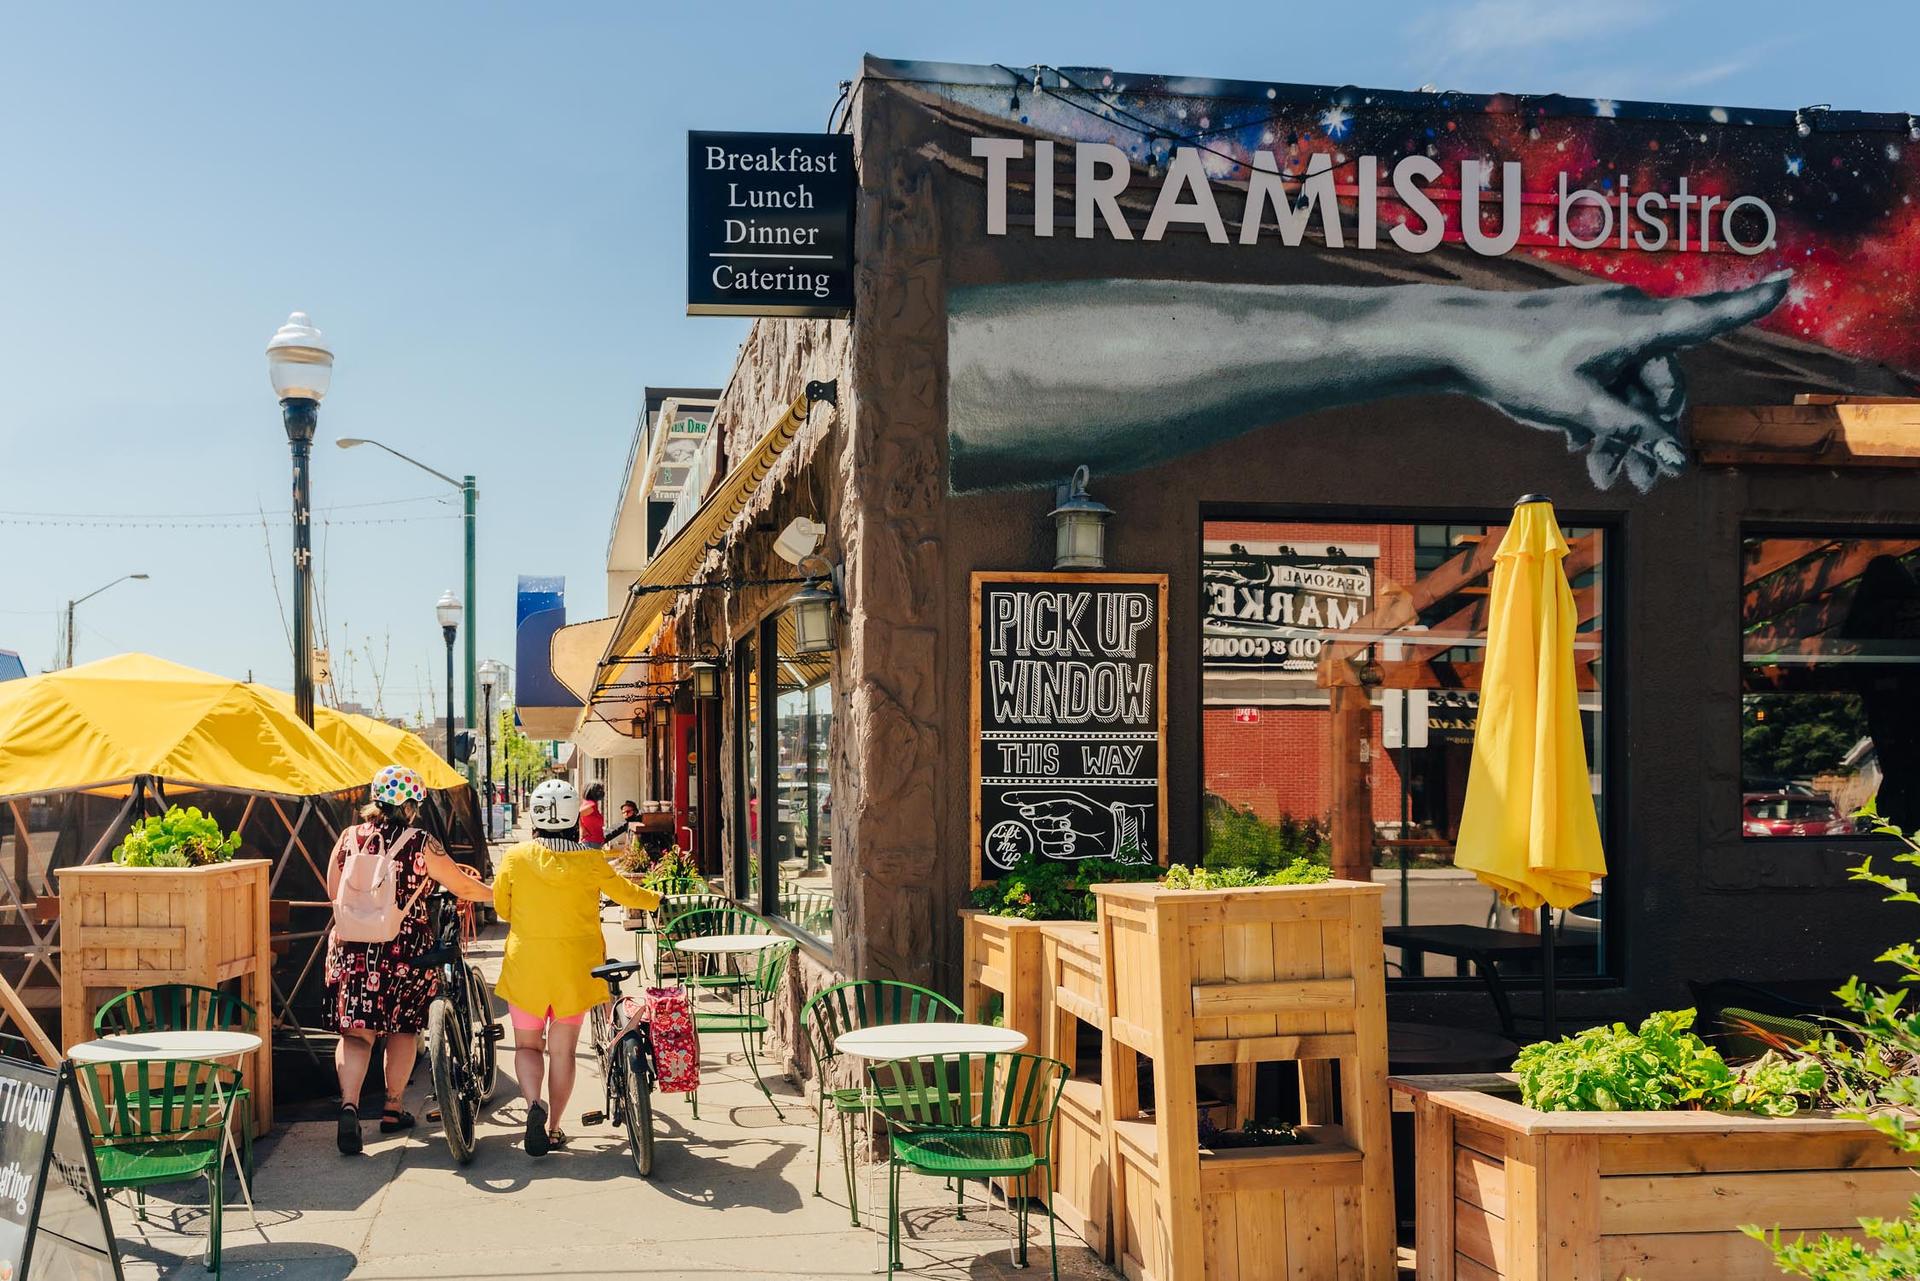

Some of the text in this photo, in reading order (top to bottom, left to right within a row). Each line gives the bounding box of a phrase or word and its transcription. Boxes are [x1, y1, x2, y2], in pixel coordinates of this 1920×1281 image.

[705, 146, 837, 173] Breakfast
[728, 183, 814, 208] Lunch
[971, 137, 1777, 256] TIRAMISU bistro
[724, 219, 819, 245] Dinner
[712, 265, 830, 298] Catering
[990, 591, 1154, 658] PICK UP
[990, 660, 1154, 724] WINDOW
[998, 743, 1143, 775] THIS WAY
[992, 824, 1022, 842] Lift
